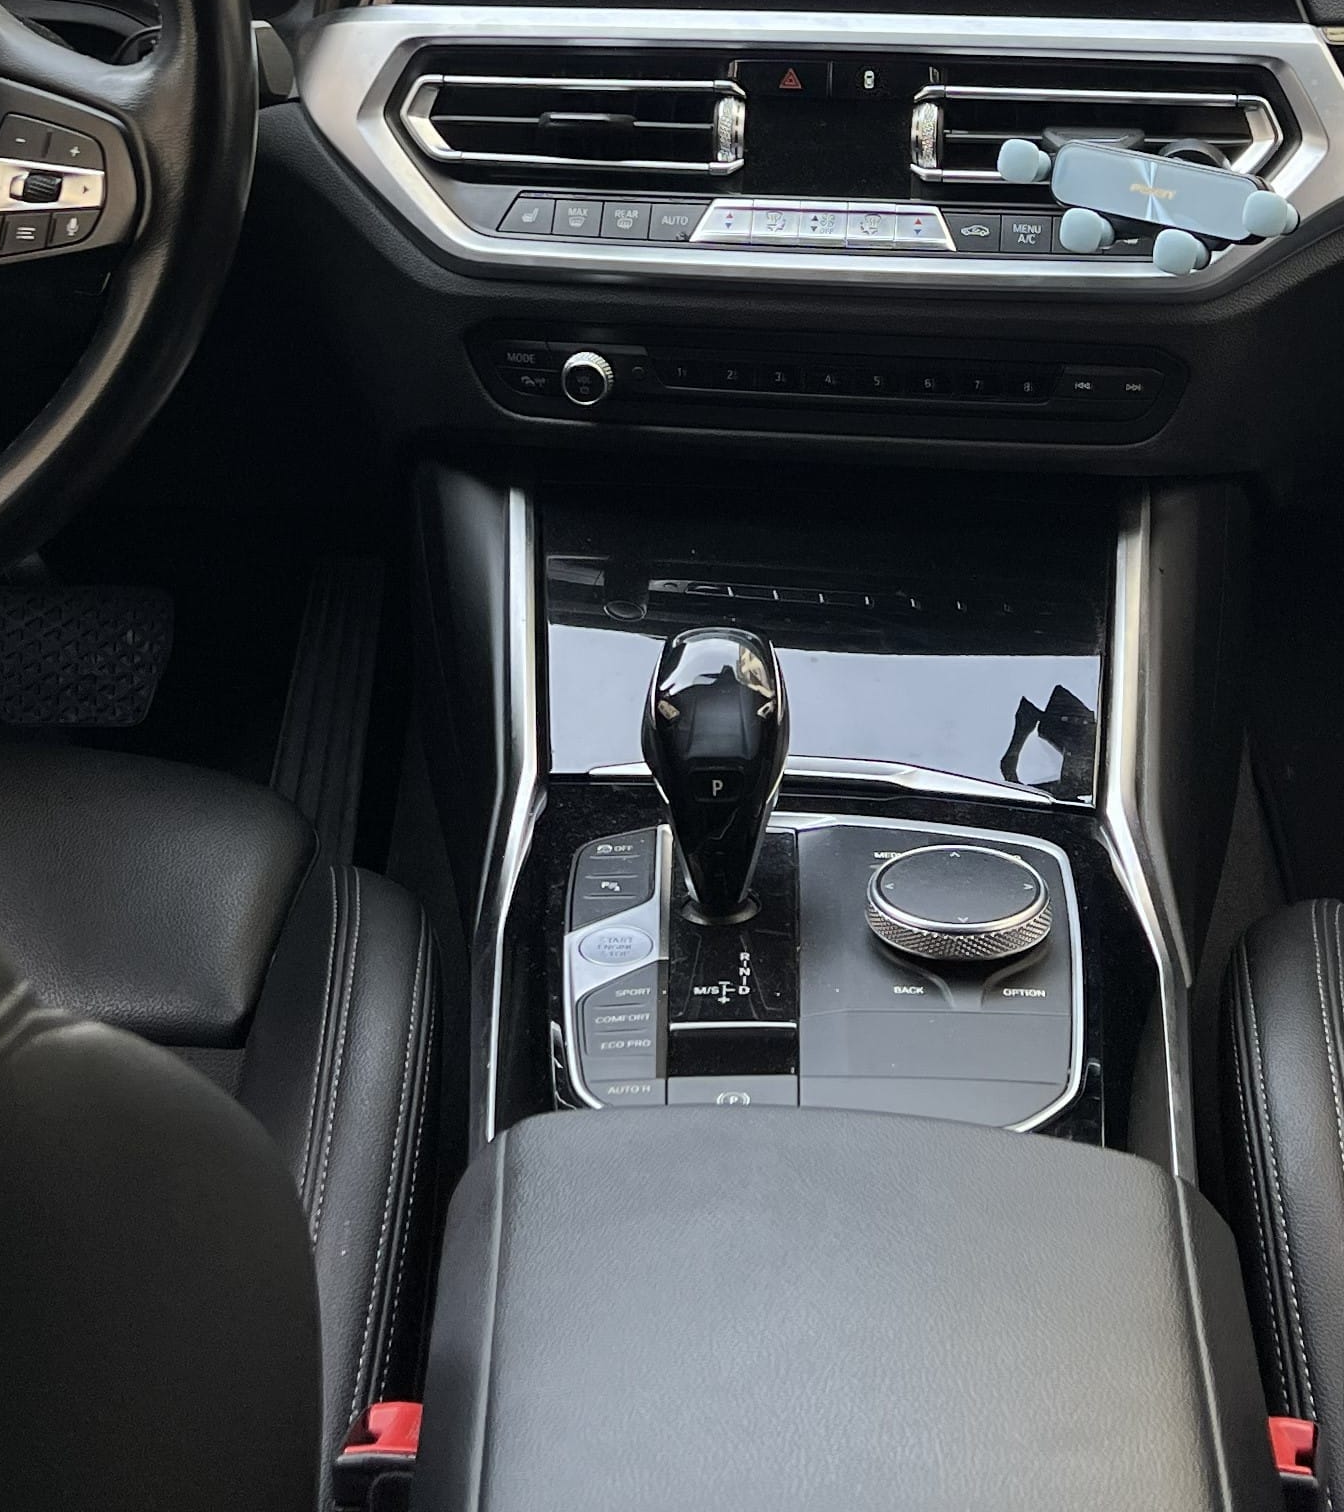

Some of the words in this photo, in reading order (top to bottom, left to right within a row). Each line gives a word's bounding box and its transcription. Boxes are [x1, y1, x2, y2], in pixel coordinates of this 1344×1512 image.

[568, 207, 588, 217] MAX
[614, 210, 639, 219] REAR
[661, 216, 688, 226] AUTO
[1013, 224, 1041, 234] MENU
[1018, 234, 1036, 245] A/C
[507, 353, 535, 364] MODE
[712, 780, 723, 796] P
[739, 952, 751, 961] R
[739, 967, 751, 977] N
[615, 989, 651, 998] SPORT
[693, 986, 720, 995] M/S
[738, 985, 751, 995] D
[893, 986, 925, 995] BACK
[1003, 988, 1046, 998] OPTION
[595, 1013, 650, 1024] COMFORT
[601, 1040, 625, 1050] ECO
[627, 1039, 652, 1049] PRO
[608, 1086, 640, 1095] AUTO
[642, 1085, 651, 1093] H
